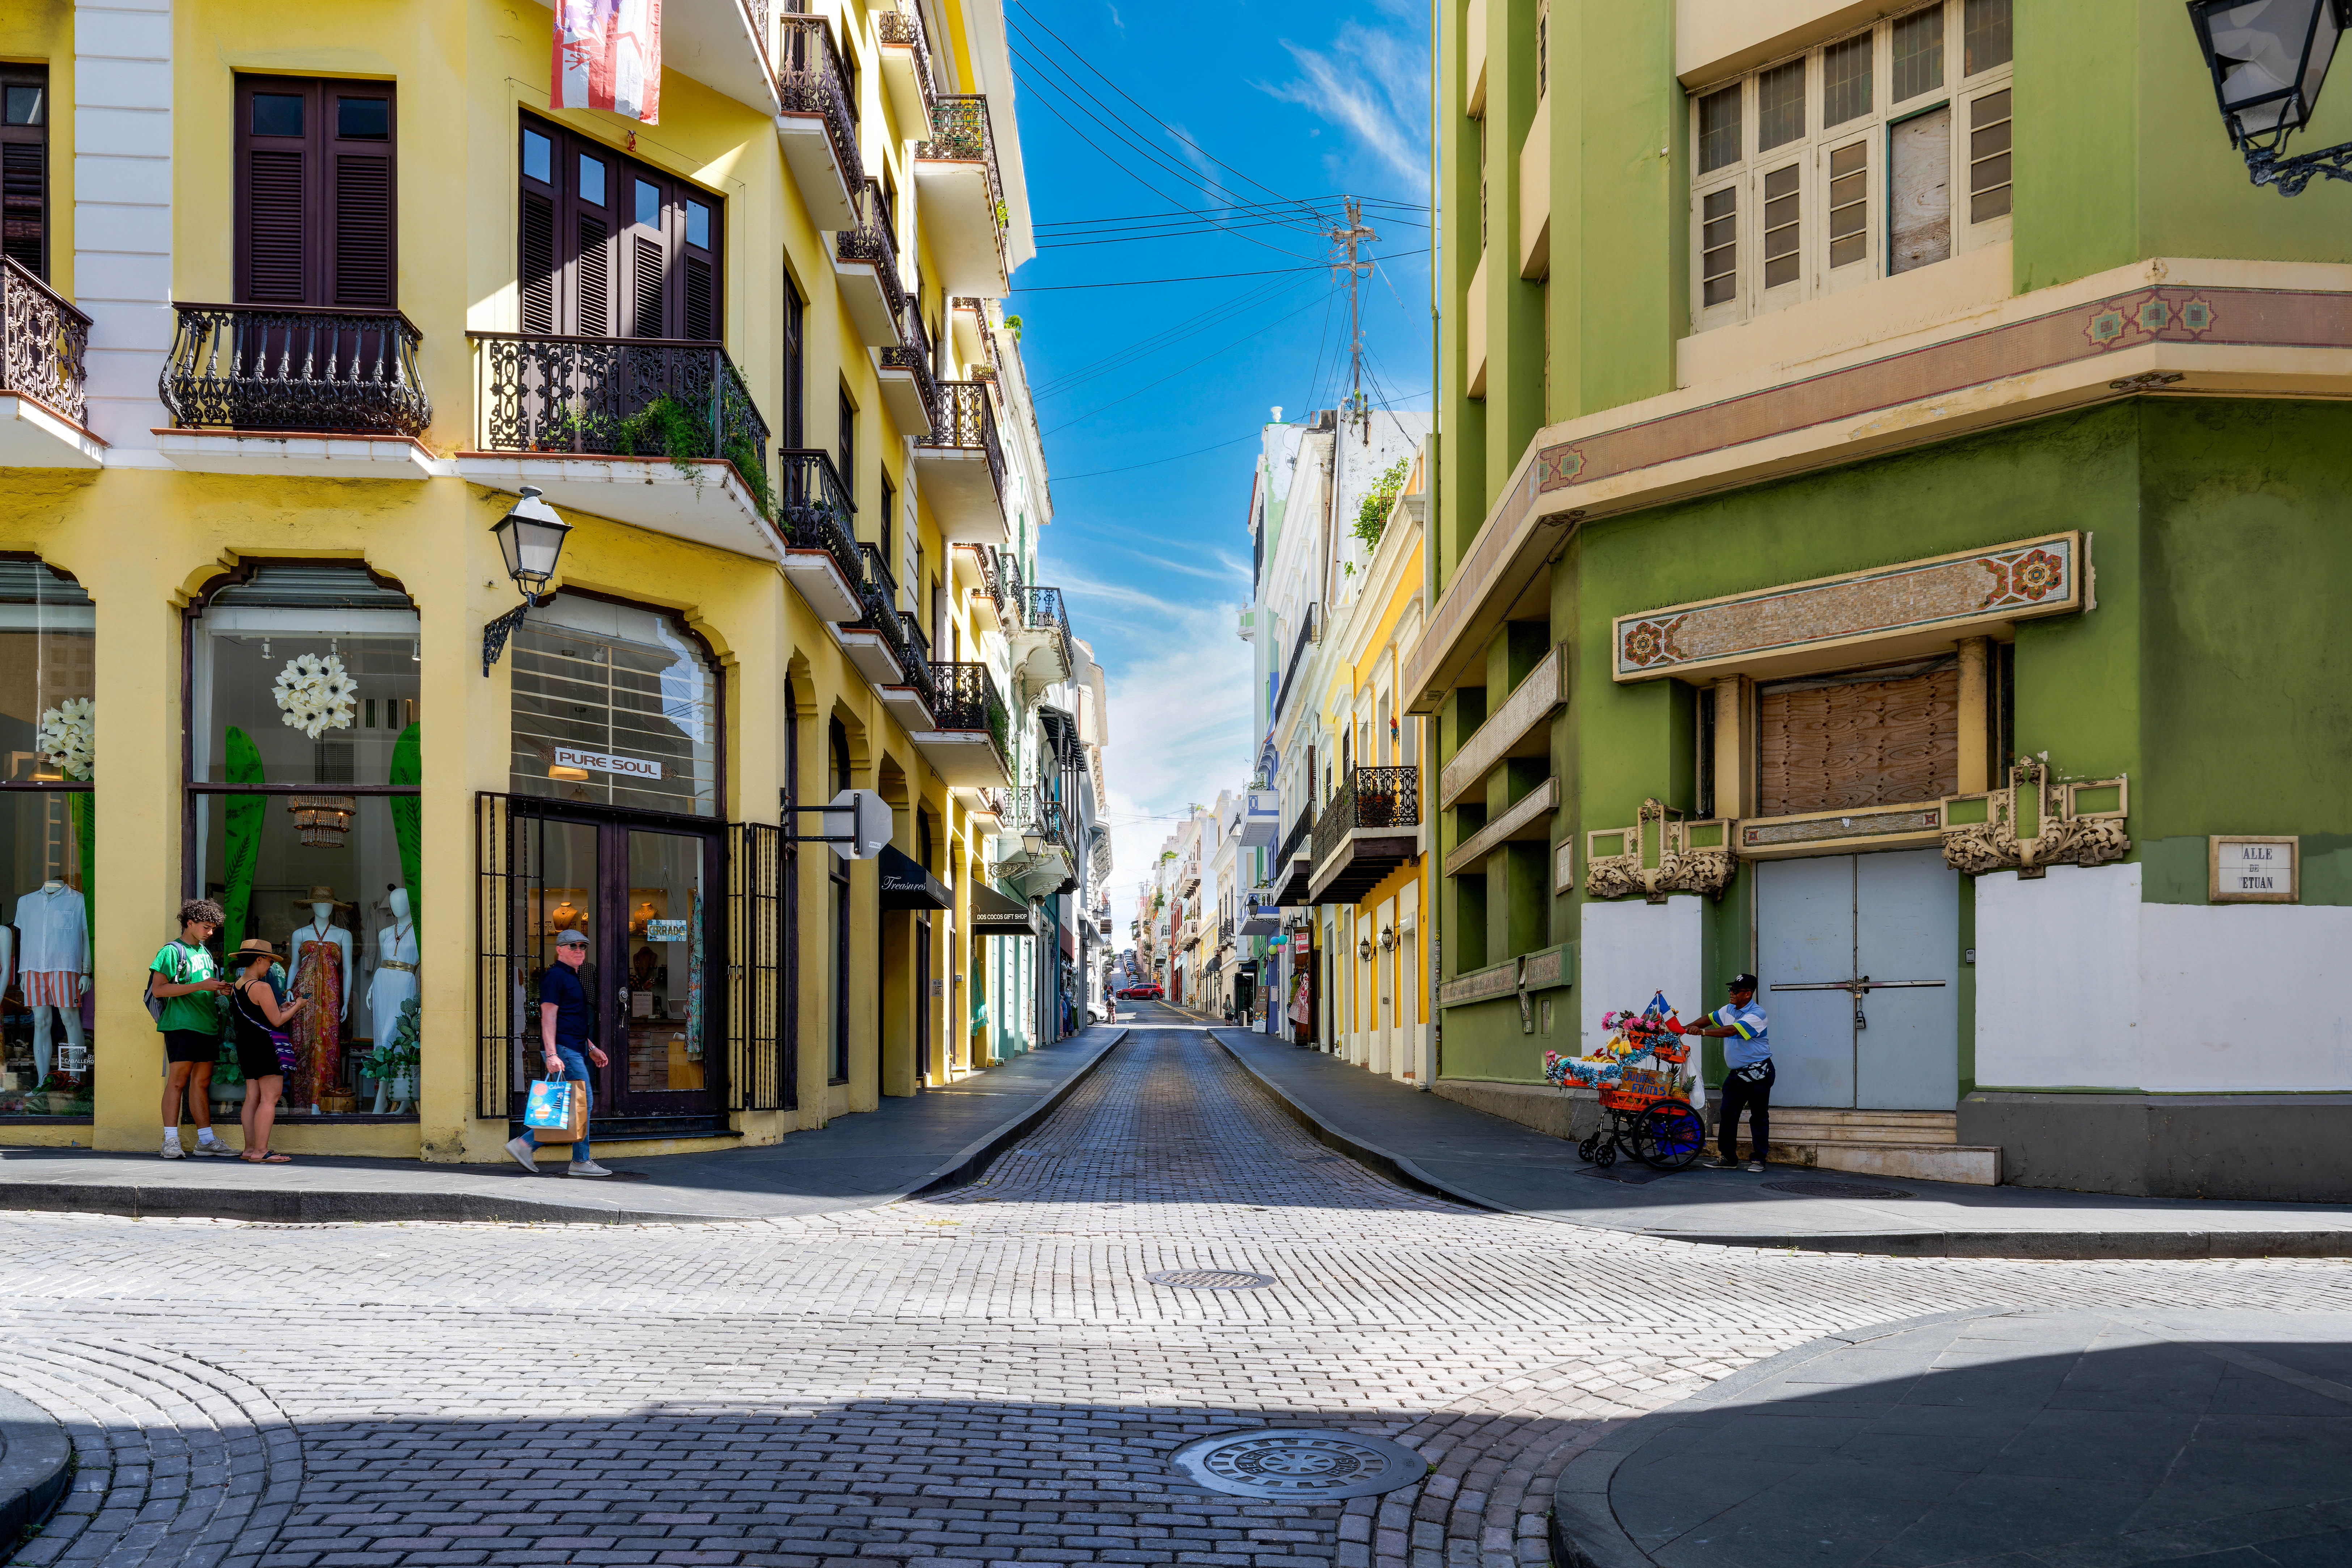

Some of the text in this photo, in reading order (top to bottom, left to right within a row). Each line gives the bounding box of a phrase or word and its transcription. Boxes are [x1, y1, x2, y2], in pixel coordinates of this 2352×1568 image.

[559, 752, 657, 775] PURE SOUL
[2242, 848, 2272, 860] ALLE
[881, 875, 926, 890] Treasures
[2237, 876, 2273, 889] TETUAN
[649, 925, 685, 936] CERRADO
[190, 954, 213, 973] BOSTO
[1237, 1450, 1271, 1473] SEWER
[1325, 1455, 1358, 1476] PRASA
